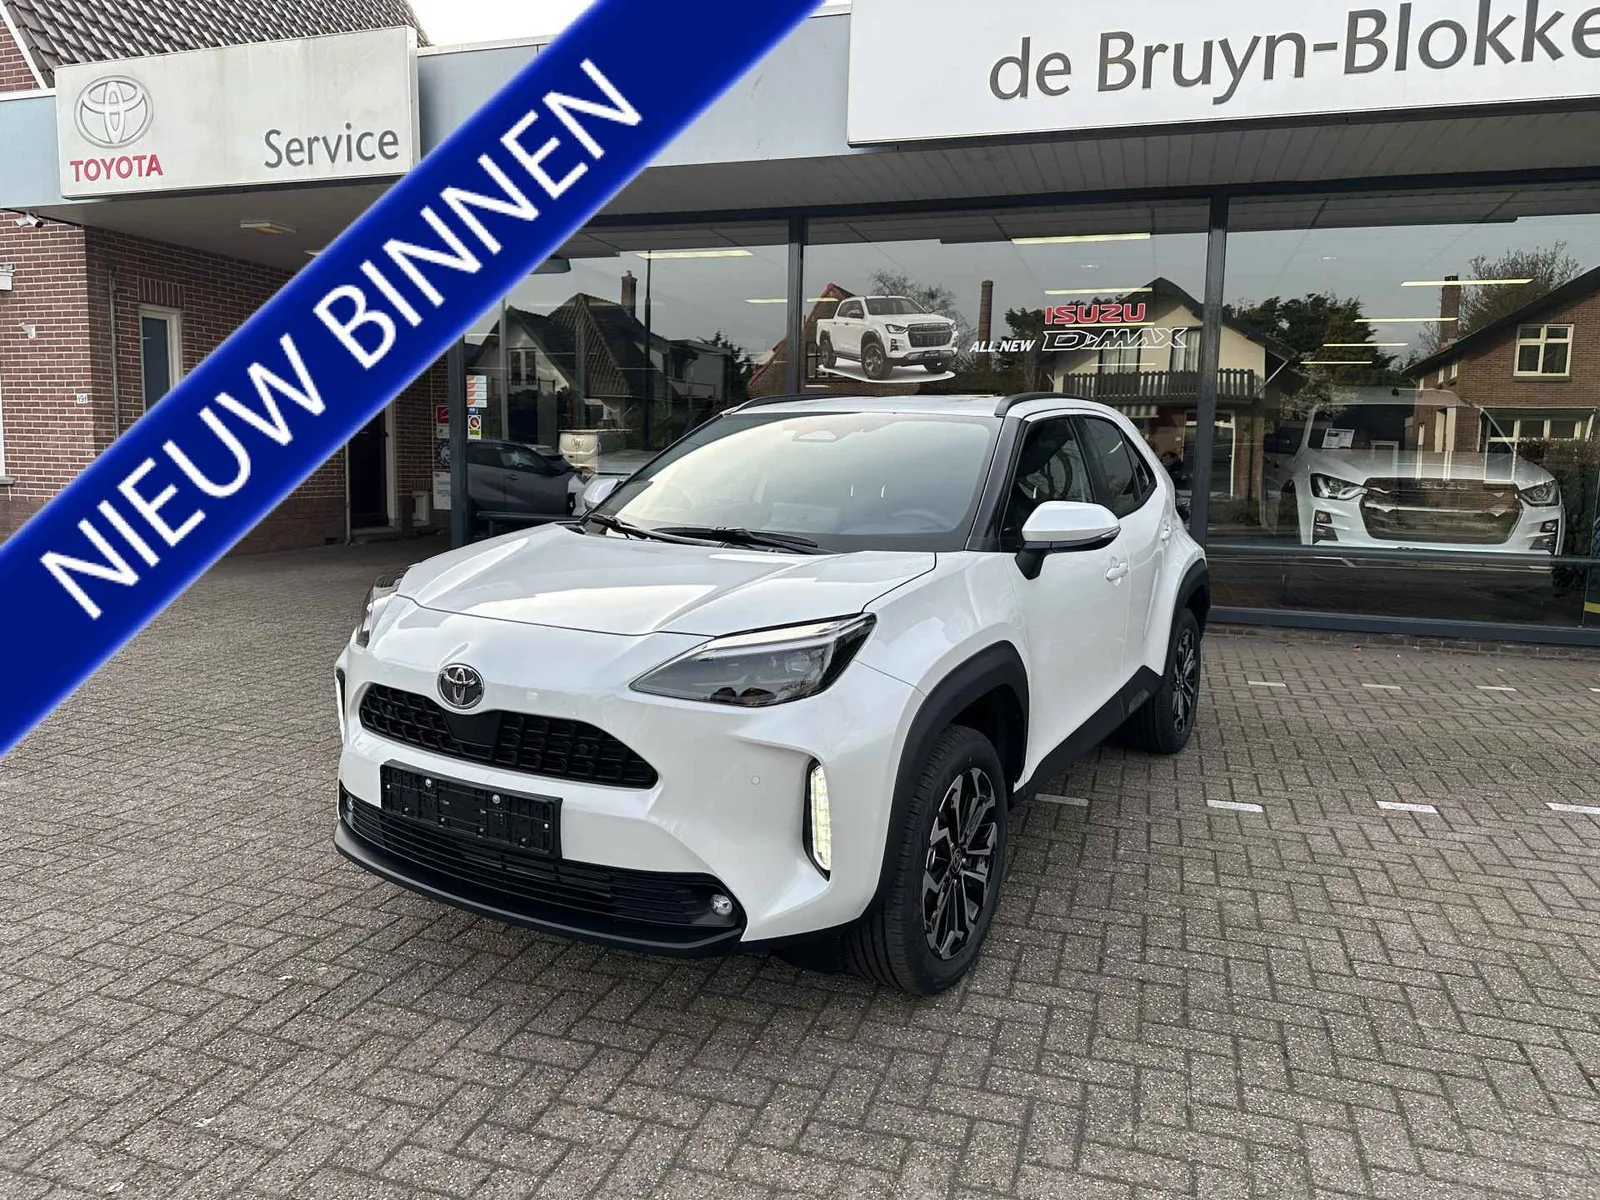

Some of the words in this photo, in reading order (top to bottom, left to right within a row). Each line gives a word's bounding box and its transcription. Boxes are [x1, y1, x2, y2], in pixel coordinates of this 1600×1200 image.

[989, 36, 1072, 101] de
[264, 122, 399, 169] Service
[70, 154, 163, 182] TOYOTA
[1045, 303, 1146, 325] ISUZU
[969, 340, 996, 353] ALL
[999, 339, 1036, 352] NEW
